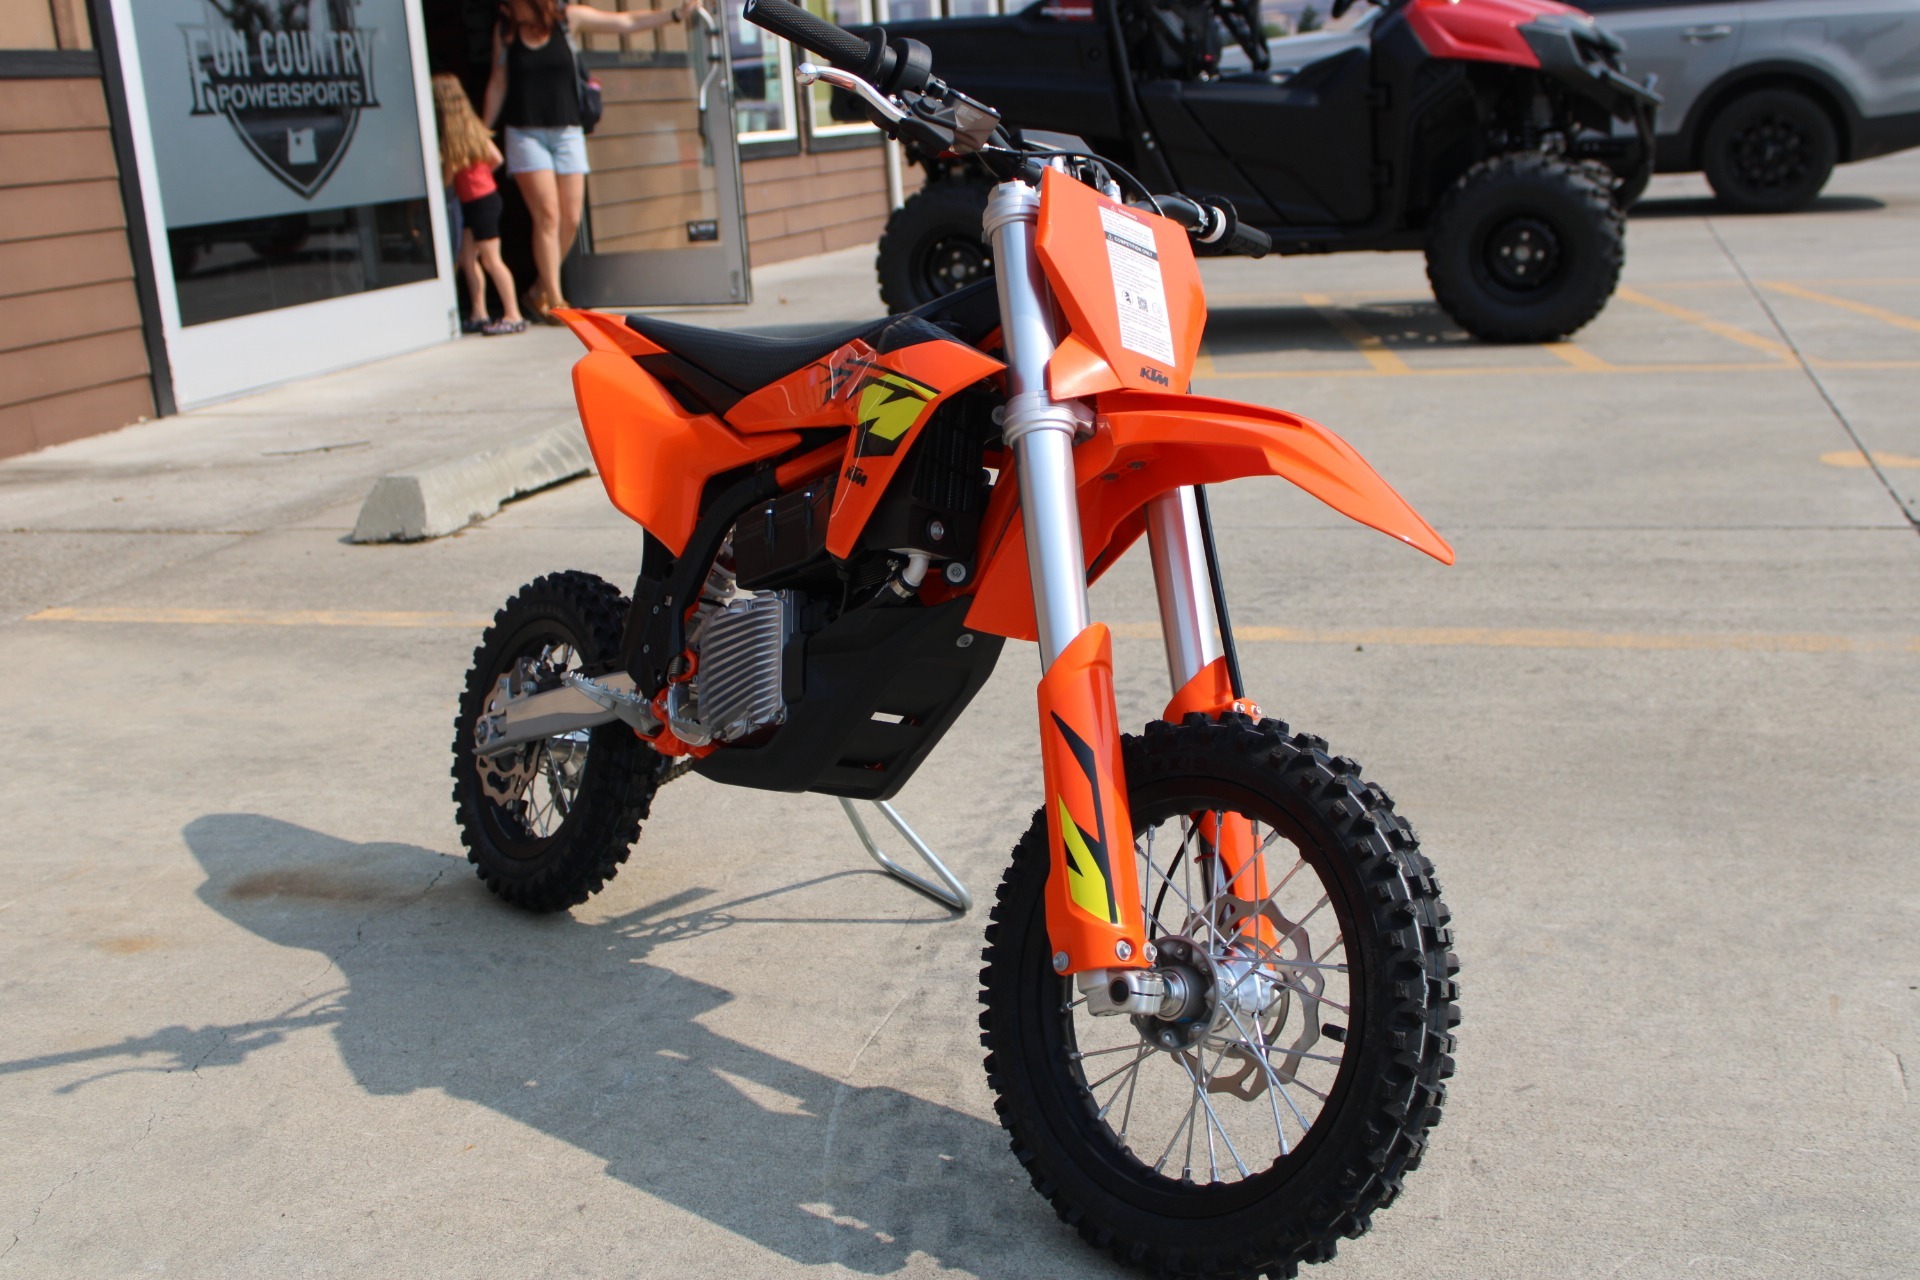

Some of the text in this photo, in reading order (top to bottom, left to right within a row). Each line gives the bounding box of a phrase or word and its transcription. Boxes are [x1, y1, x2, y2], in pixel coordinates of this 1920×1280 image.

[176, 24, 381, 116] FUN COUNTRY
[216, 81, 361, 110] POWERSPORTS
[1140, 366, 1169, 387] KTM
[844, 465, 868, 487] KTM
